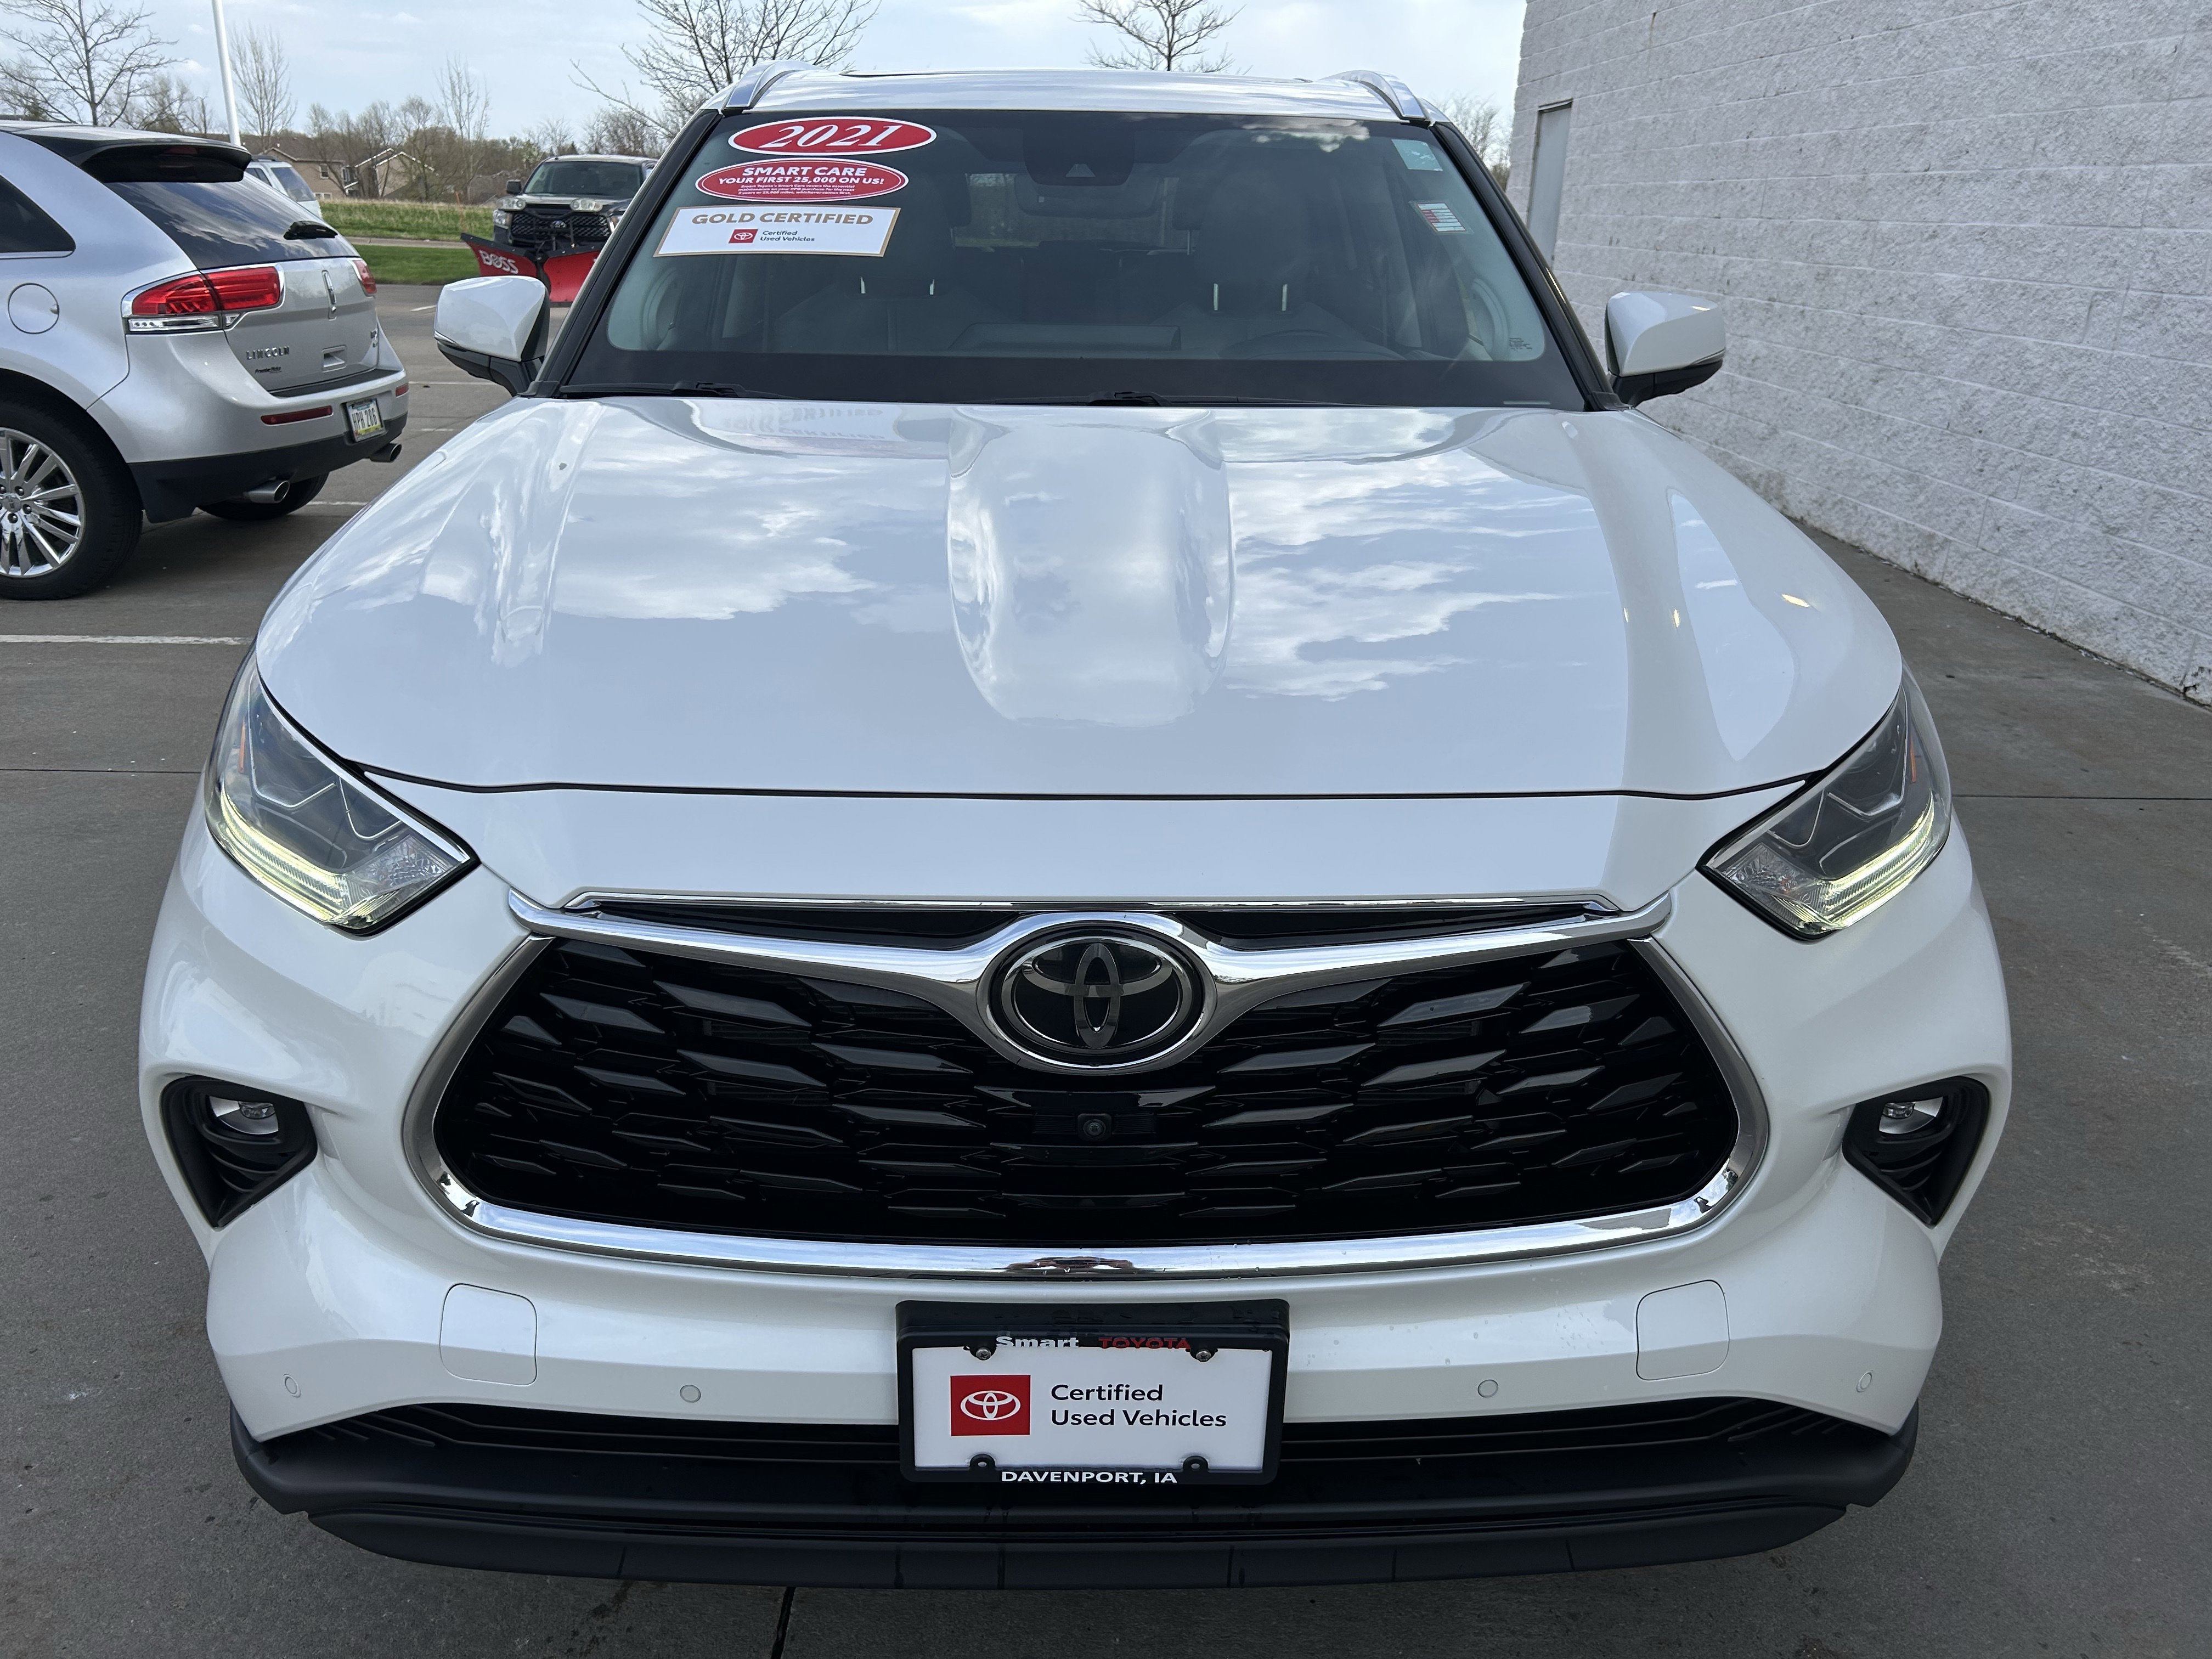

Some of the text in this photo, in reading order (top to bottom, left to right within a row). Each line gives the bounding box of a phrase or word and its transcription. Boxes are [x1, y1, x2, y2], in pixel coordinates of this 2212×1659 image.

[758, 125, 904, 149] 2021
[742, 167, 868, 177] SMART CARE
[793, 177, 838, 185] 25,000
[692, 212, 873, 225] GOLD CERTIFIED
[478, 250, 519, 274] BOSS
[246, 345, 290, 360] LINCOLN
[996, 1336, 1191, 1349] Smart TOYOTA
[1051, 1384, 1164, 1402] Certified
[1051, 1409, 1227, 1427] Used Vehicles
[1001, 1471, 1178, 1485] DAVENPORT, IA
